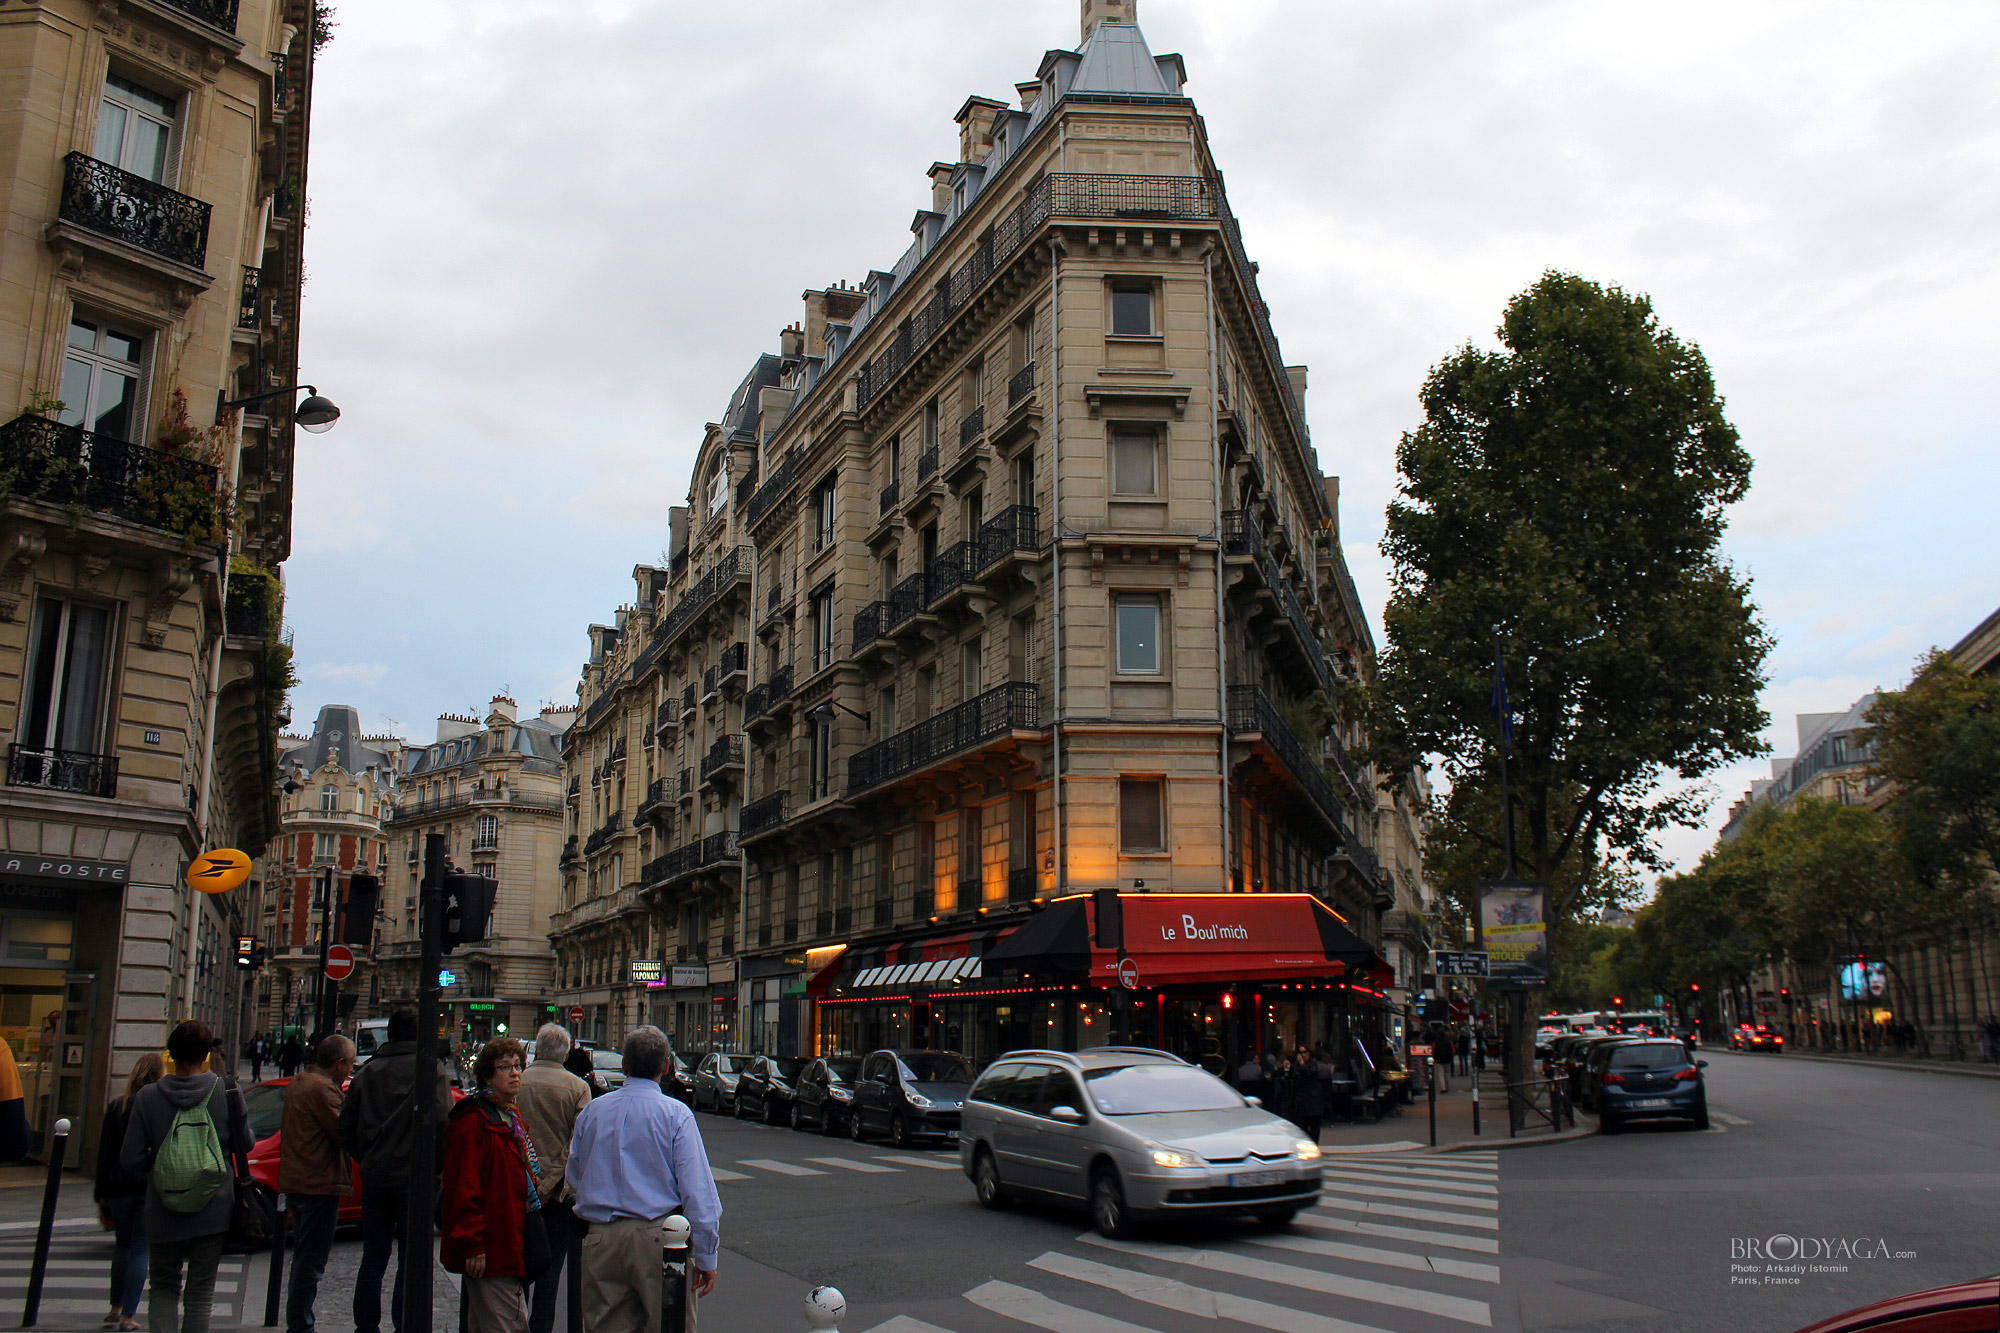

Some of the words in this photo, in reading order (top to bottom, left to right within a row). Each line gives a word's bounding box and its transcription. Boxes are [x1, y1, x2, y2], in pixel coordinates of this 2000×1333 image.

[146, 732, 159, 743] 118
[5, 859, 21, 871] A
[38, 862, 125, 880] POSTE
[1161, 925, 1176, 940] Le
[1181, 913, 1249, 941] Boul'mich
[632, 962, 661, 971] RESTAURANT
[632, 972, 660, 982] JAPONAIS
